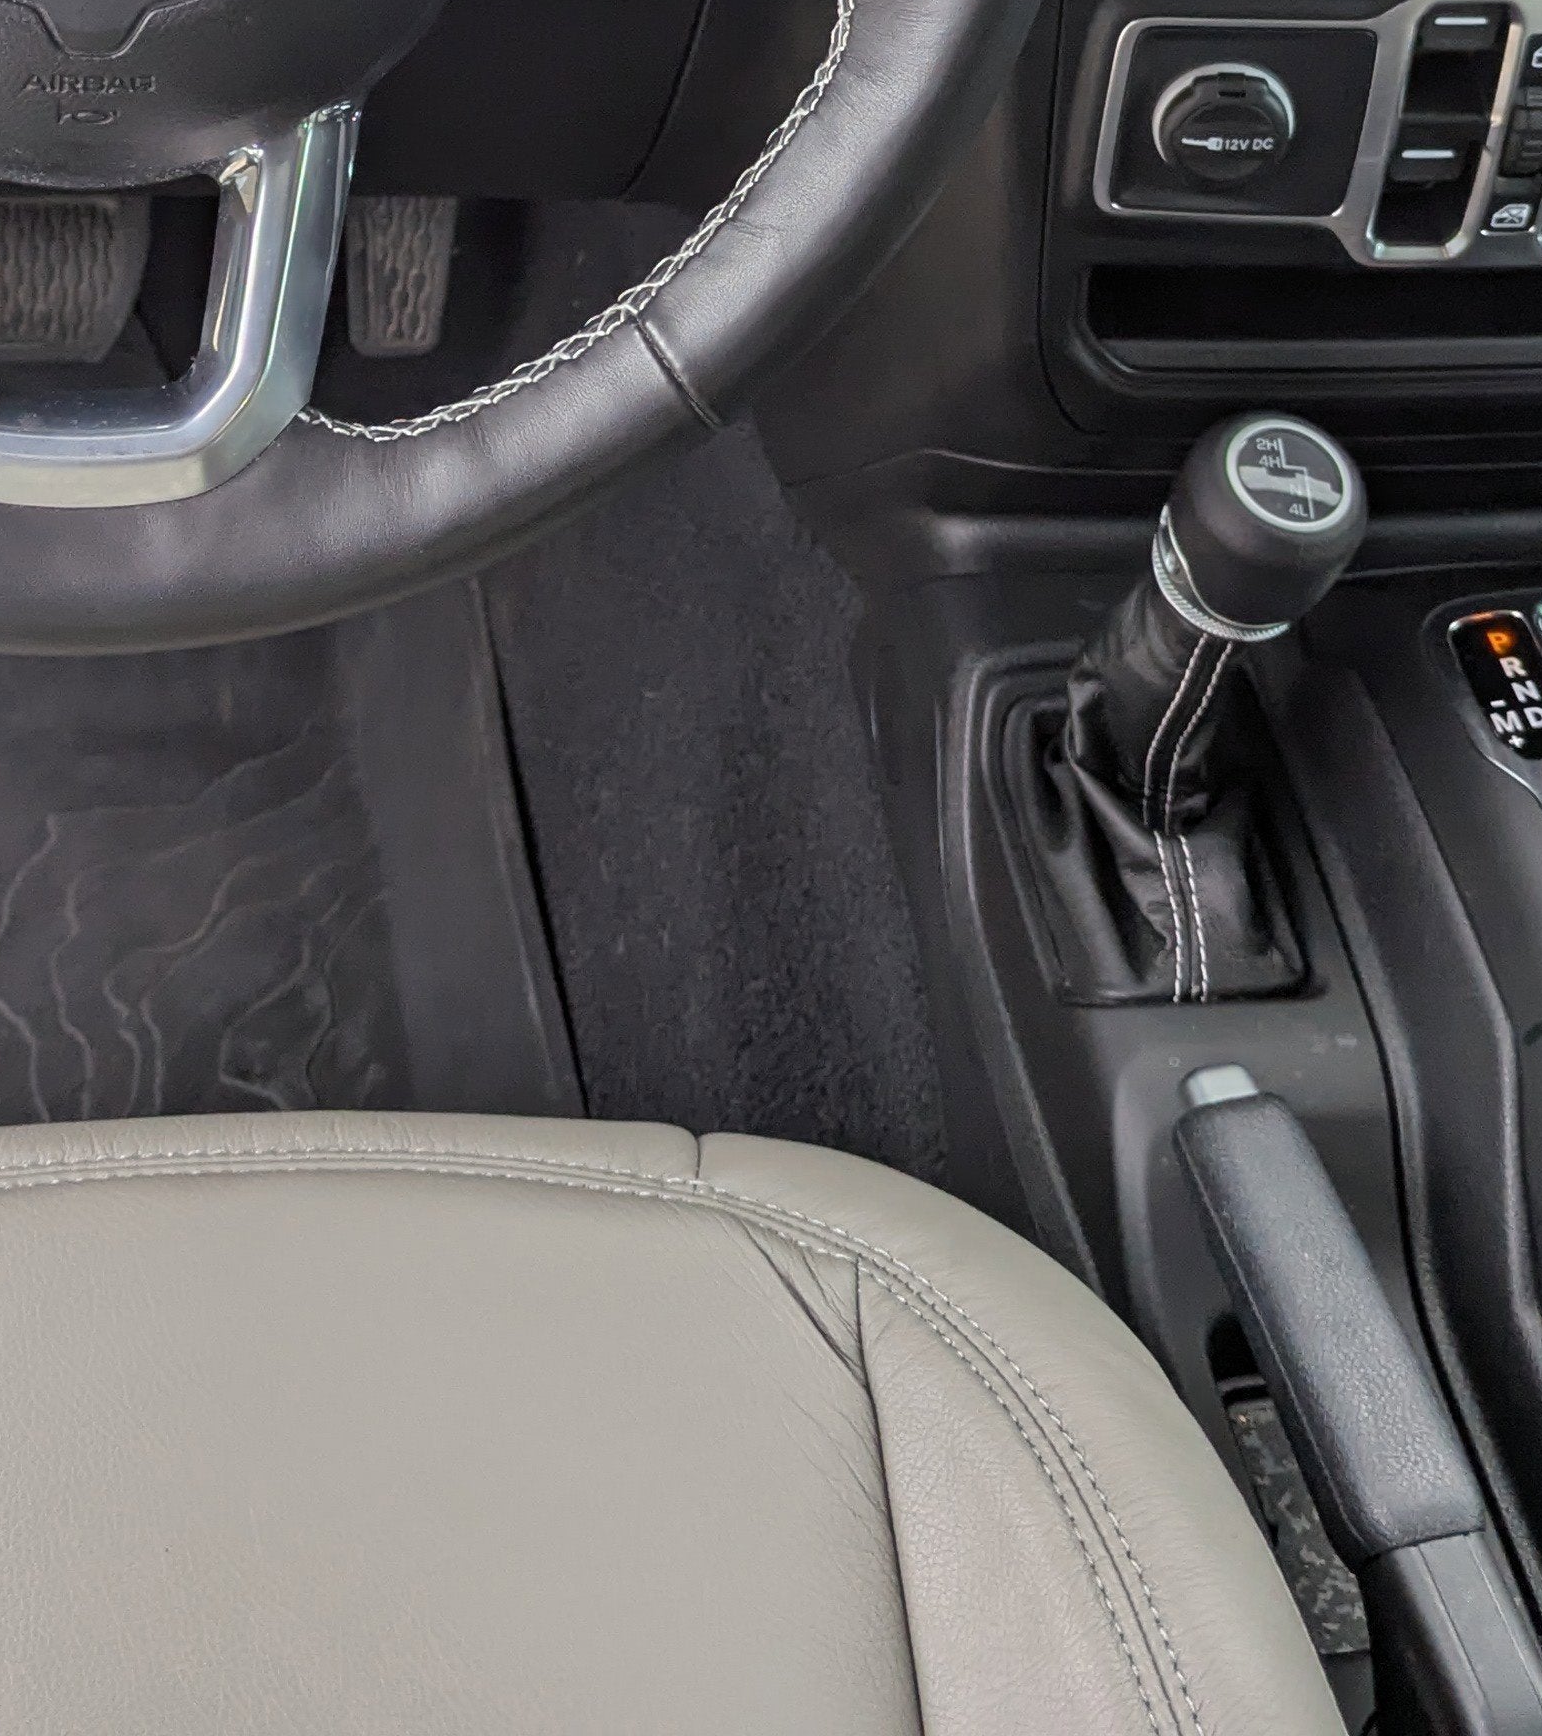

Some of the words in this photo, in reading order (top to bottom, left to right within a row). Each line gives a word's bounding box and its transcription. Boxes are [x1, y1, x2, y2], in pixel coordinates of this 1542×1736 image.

[1224, 138, 1251, 152] 12V
[1251, 137, 1275, 151] DC
[1255, 436, 1279, 452] 2H
[1258, 454, 1282, 469] 4H
[1287, 502, 1309, 518] 4L
[1486, 630, 1513, 656] P
[1498, 655, 1529, 679] R
[1510, 679, 1542, 704] N
[1489, 709, 1525, 735] M
